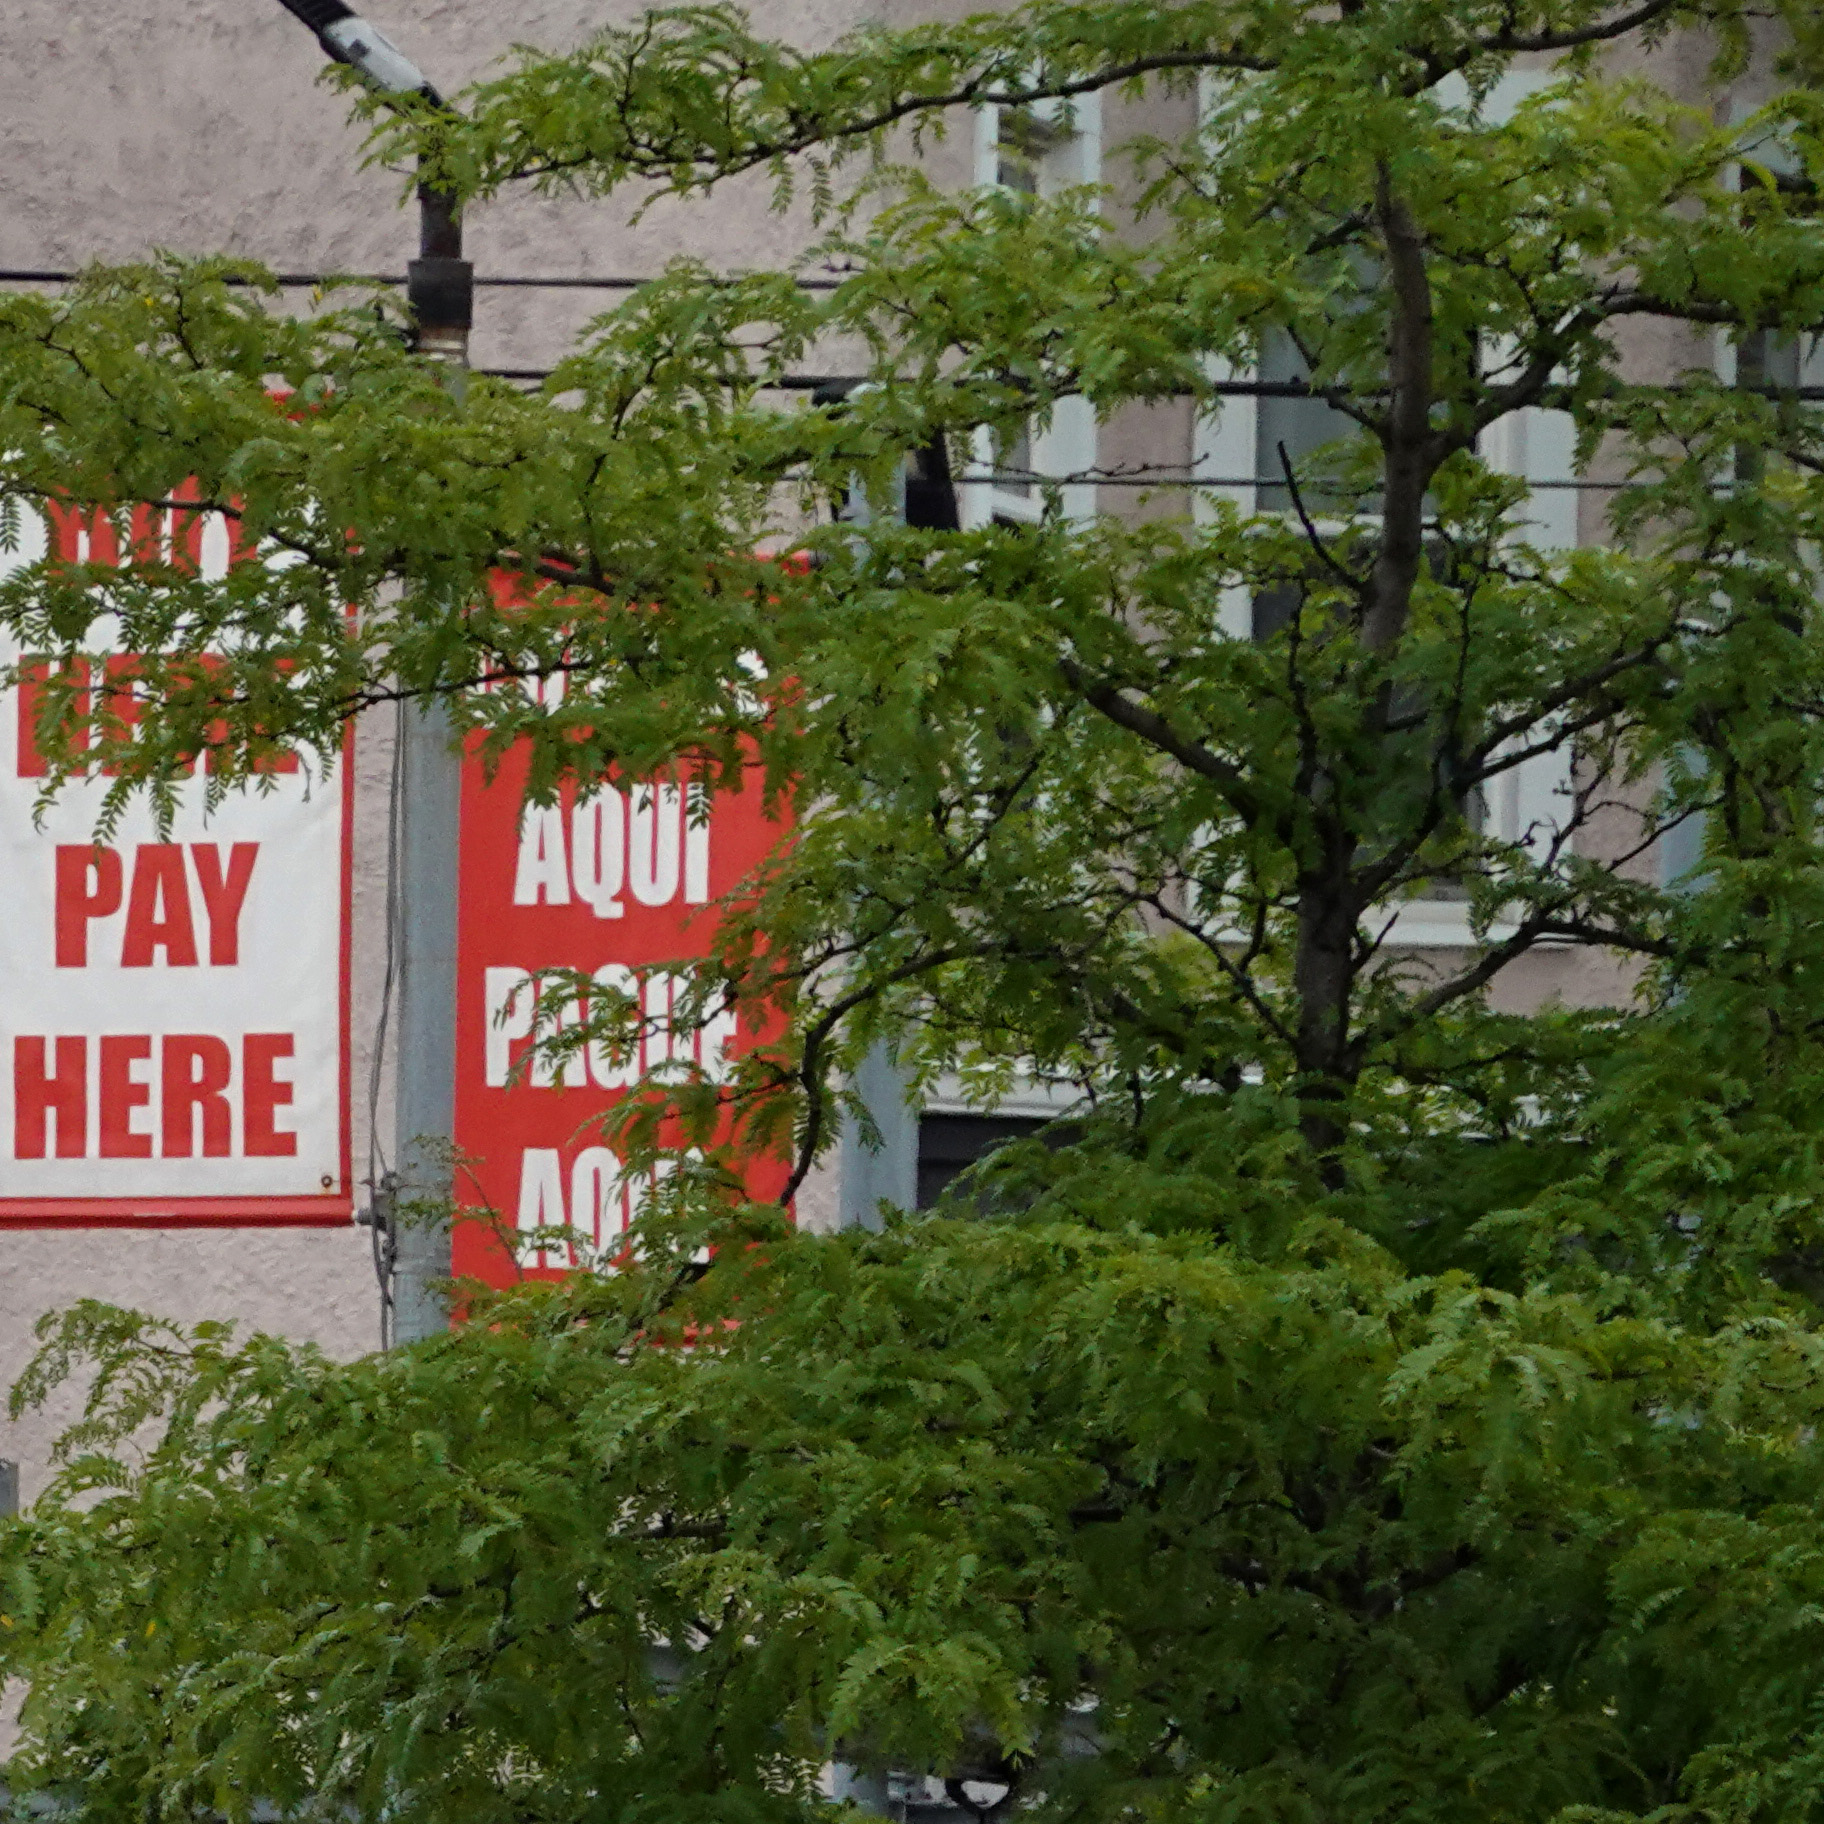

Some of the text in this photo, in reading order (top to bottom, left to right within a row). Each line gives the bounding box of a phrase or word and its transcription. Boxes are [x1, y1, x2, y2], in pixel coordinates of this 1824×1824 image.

[55, 842, 260, 968] PAY
[513, 779, 711, 919] AQUI
[13, 1033, 298, 1160] HERE
